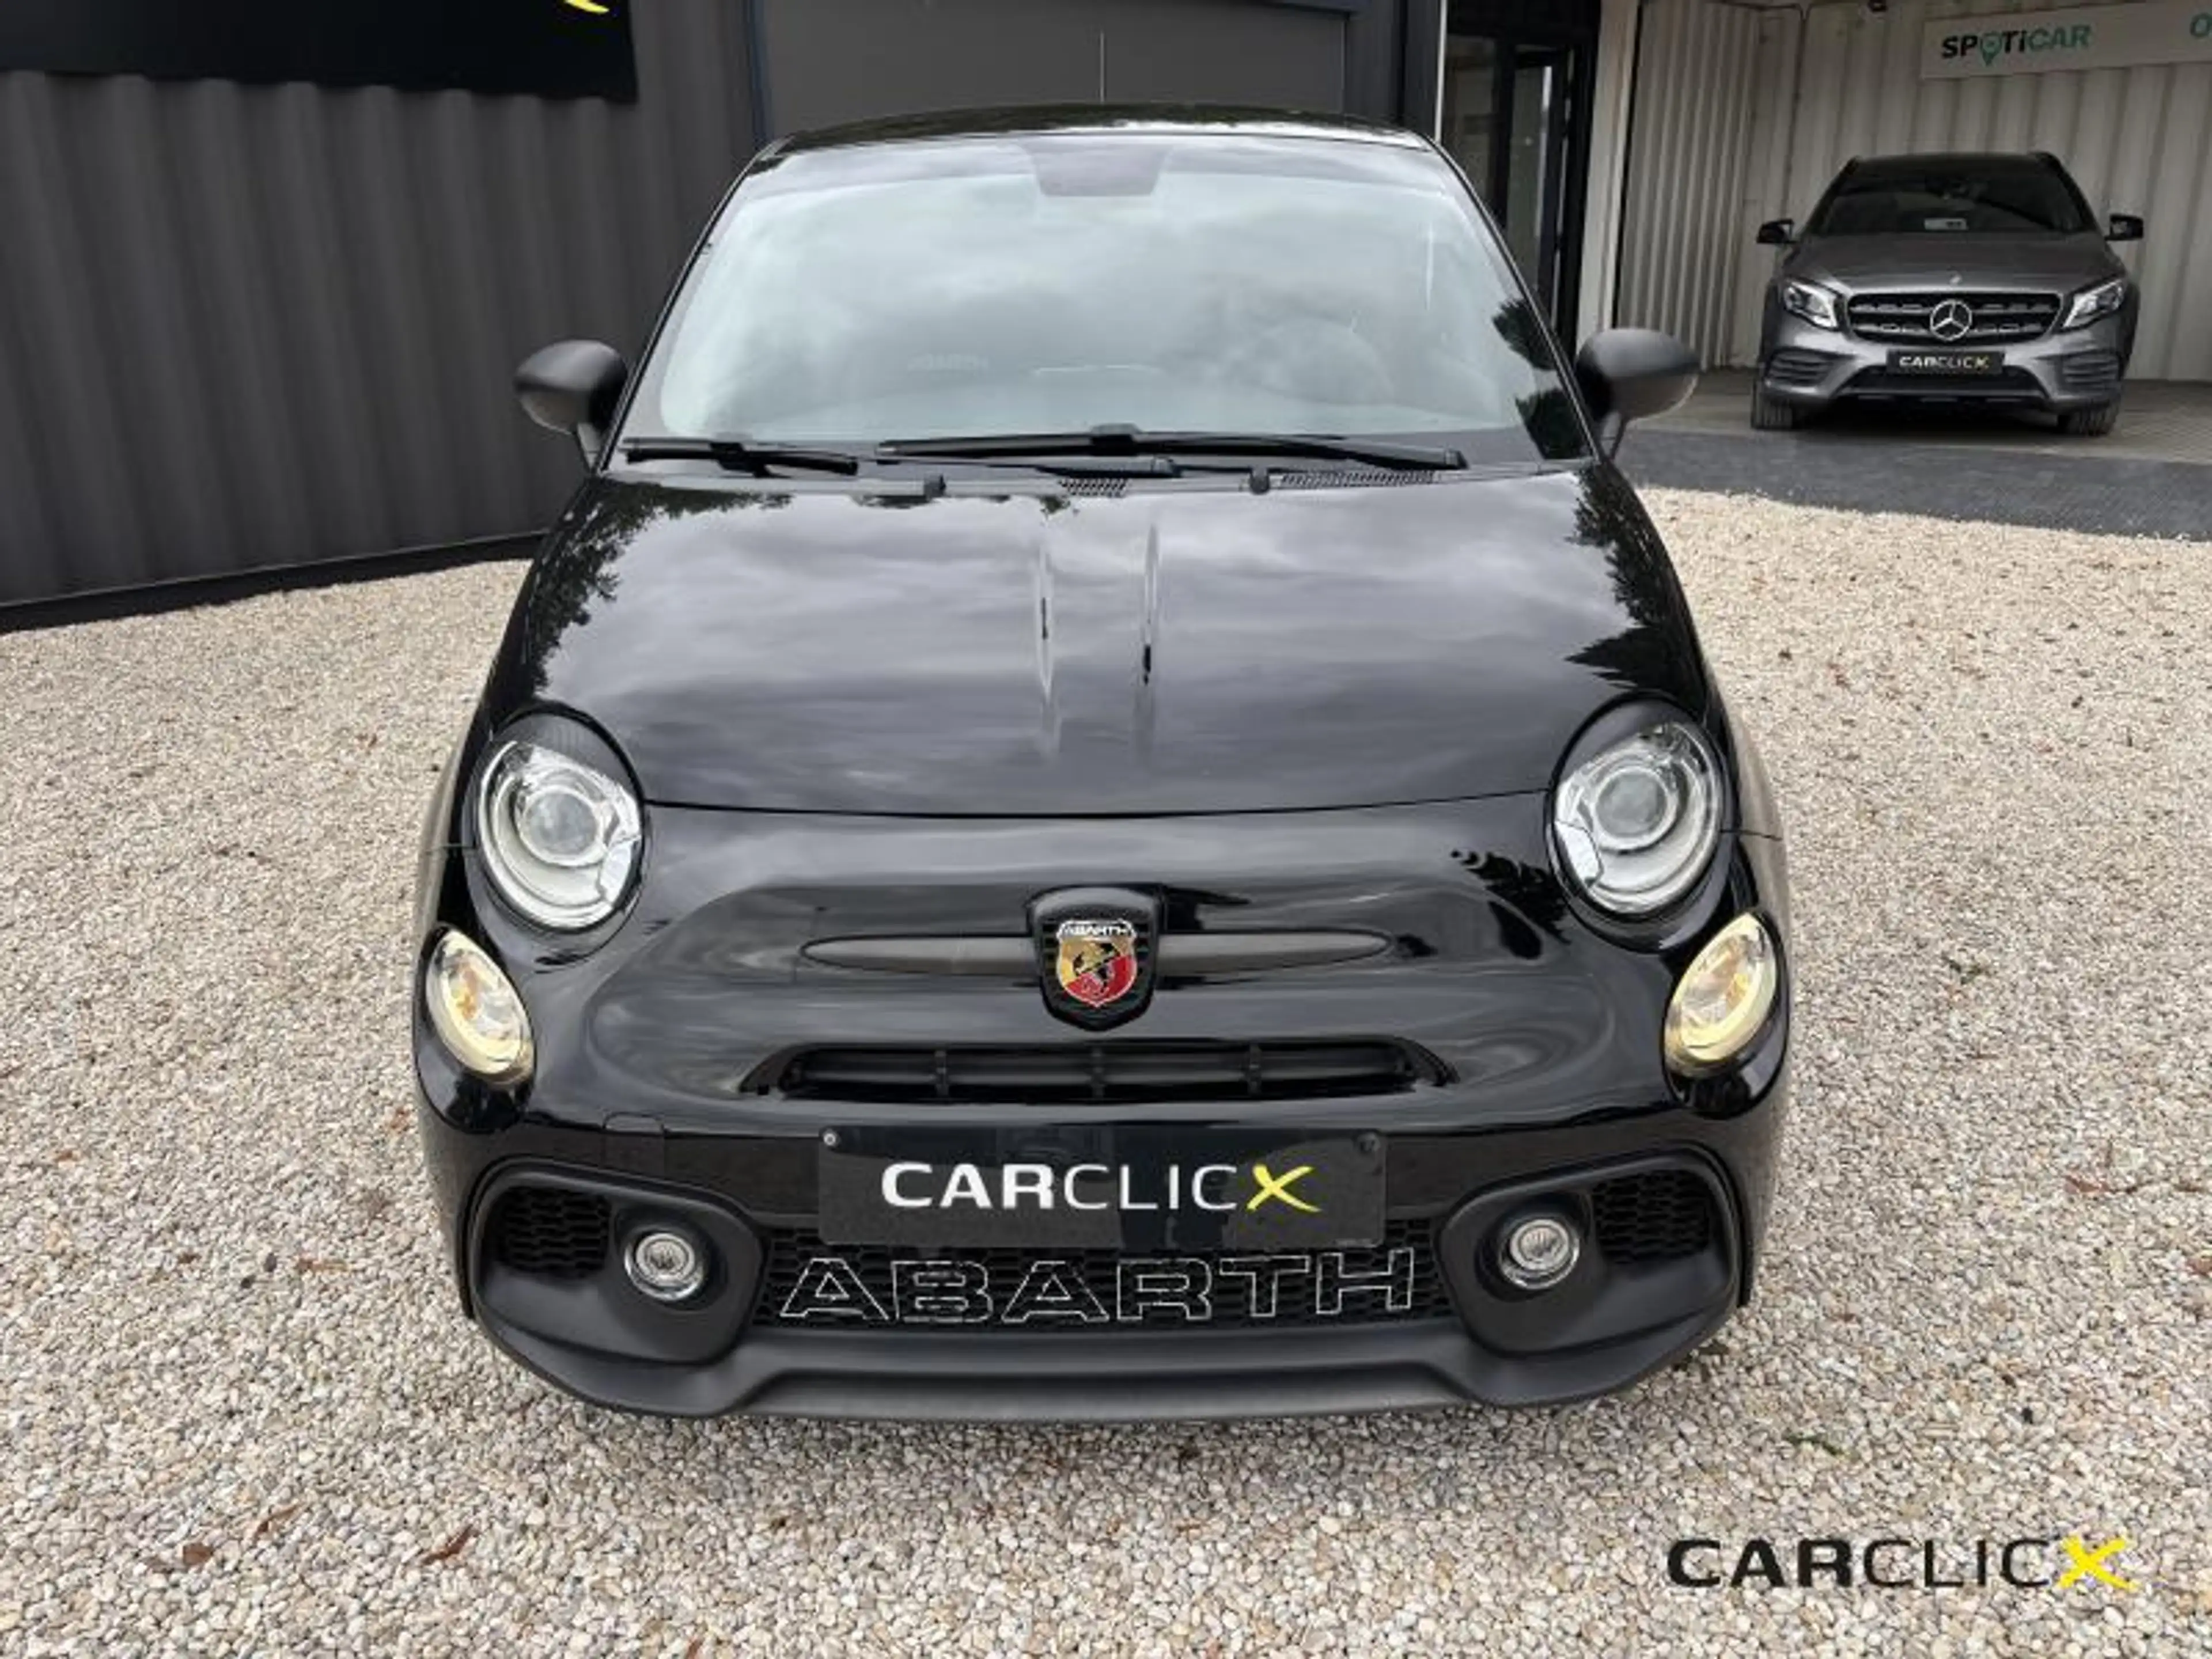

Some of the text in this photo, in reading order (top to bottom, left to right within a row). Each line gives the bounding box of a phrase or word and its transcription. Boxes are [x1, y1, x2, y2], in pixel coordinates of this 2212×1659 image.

[1941, 24, 2092, 66] SPOTICAR
[1064, 925, 1131, 936] ABARTH
[881, 1161, 1322, 1213] CARCLICX
[779, 1248, 1414, 1323] ABARTH
